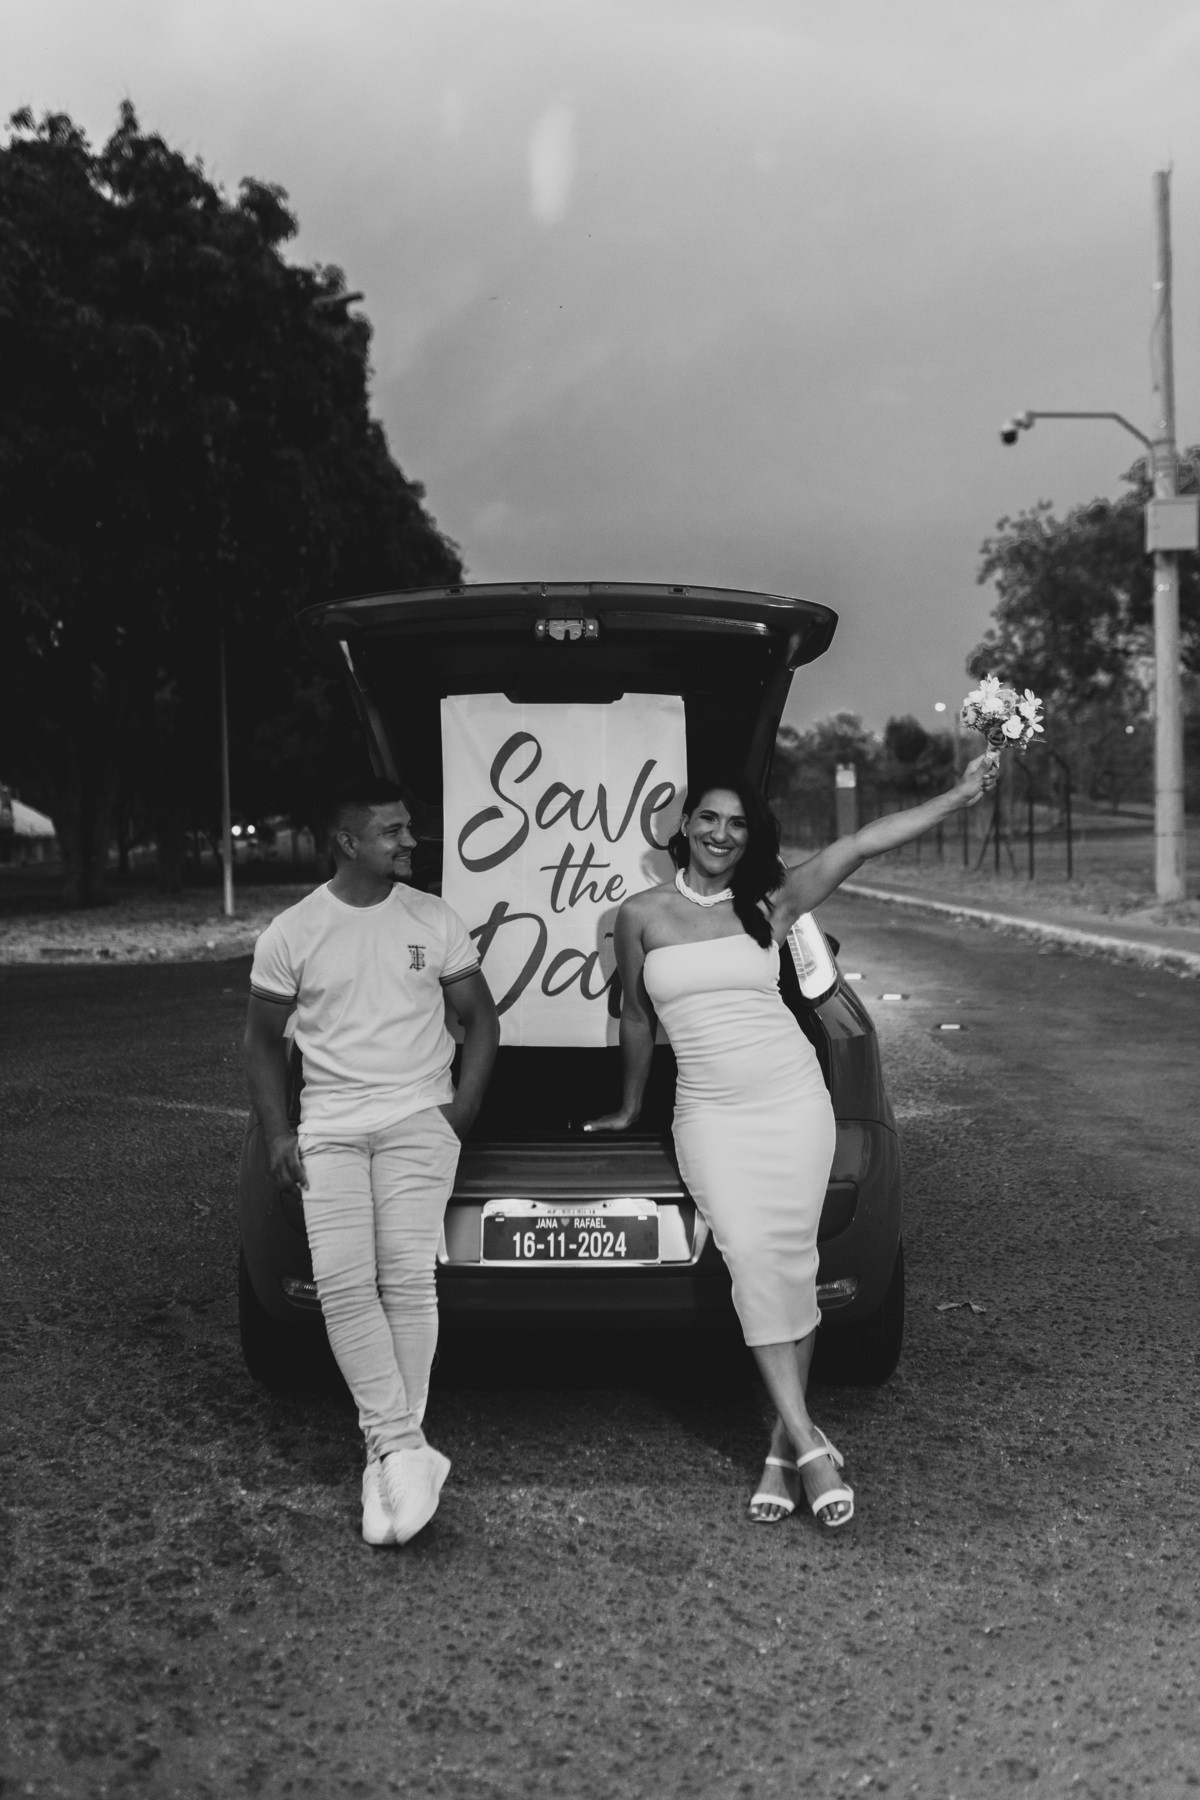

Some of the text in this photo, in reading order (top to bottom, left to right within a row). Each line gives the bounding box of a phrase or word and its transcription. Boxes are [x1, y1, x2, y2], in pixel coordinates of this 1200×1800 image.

[458, 731, 677, 873] Save
[539, 842, 627, 914] the
[512, 1231, 627, 1258] 16-11-2024
[535, 1217, 606, 1229] JANA RAFAEL
